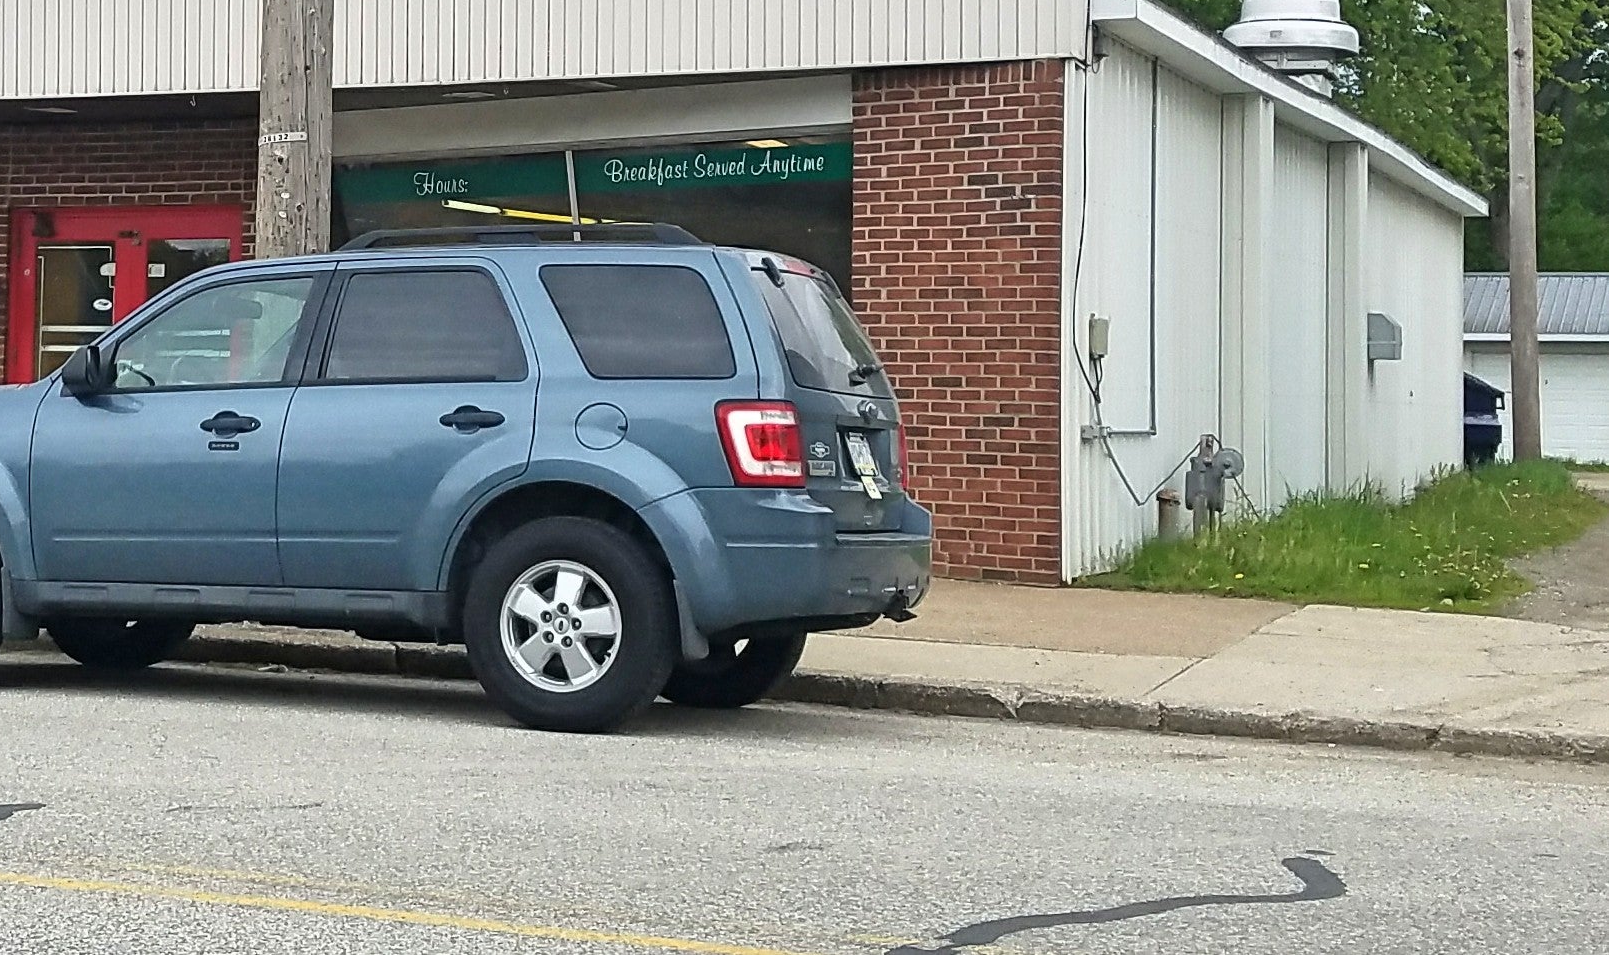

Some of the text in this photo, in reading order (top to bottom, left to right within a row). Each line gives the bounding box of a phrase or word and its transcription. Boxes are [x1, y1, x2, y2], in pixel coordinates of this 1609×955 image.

[604, 150, 825, 186] Breakfast Served Anytime
[413, 172, 469, 196] Hours:
